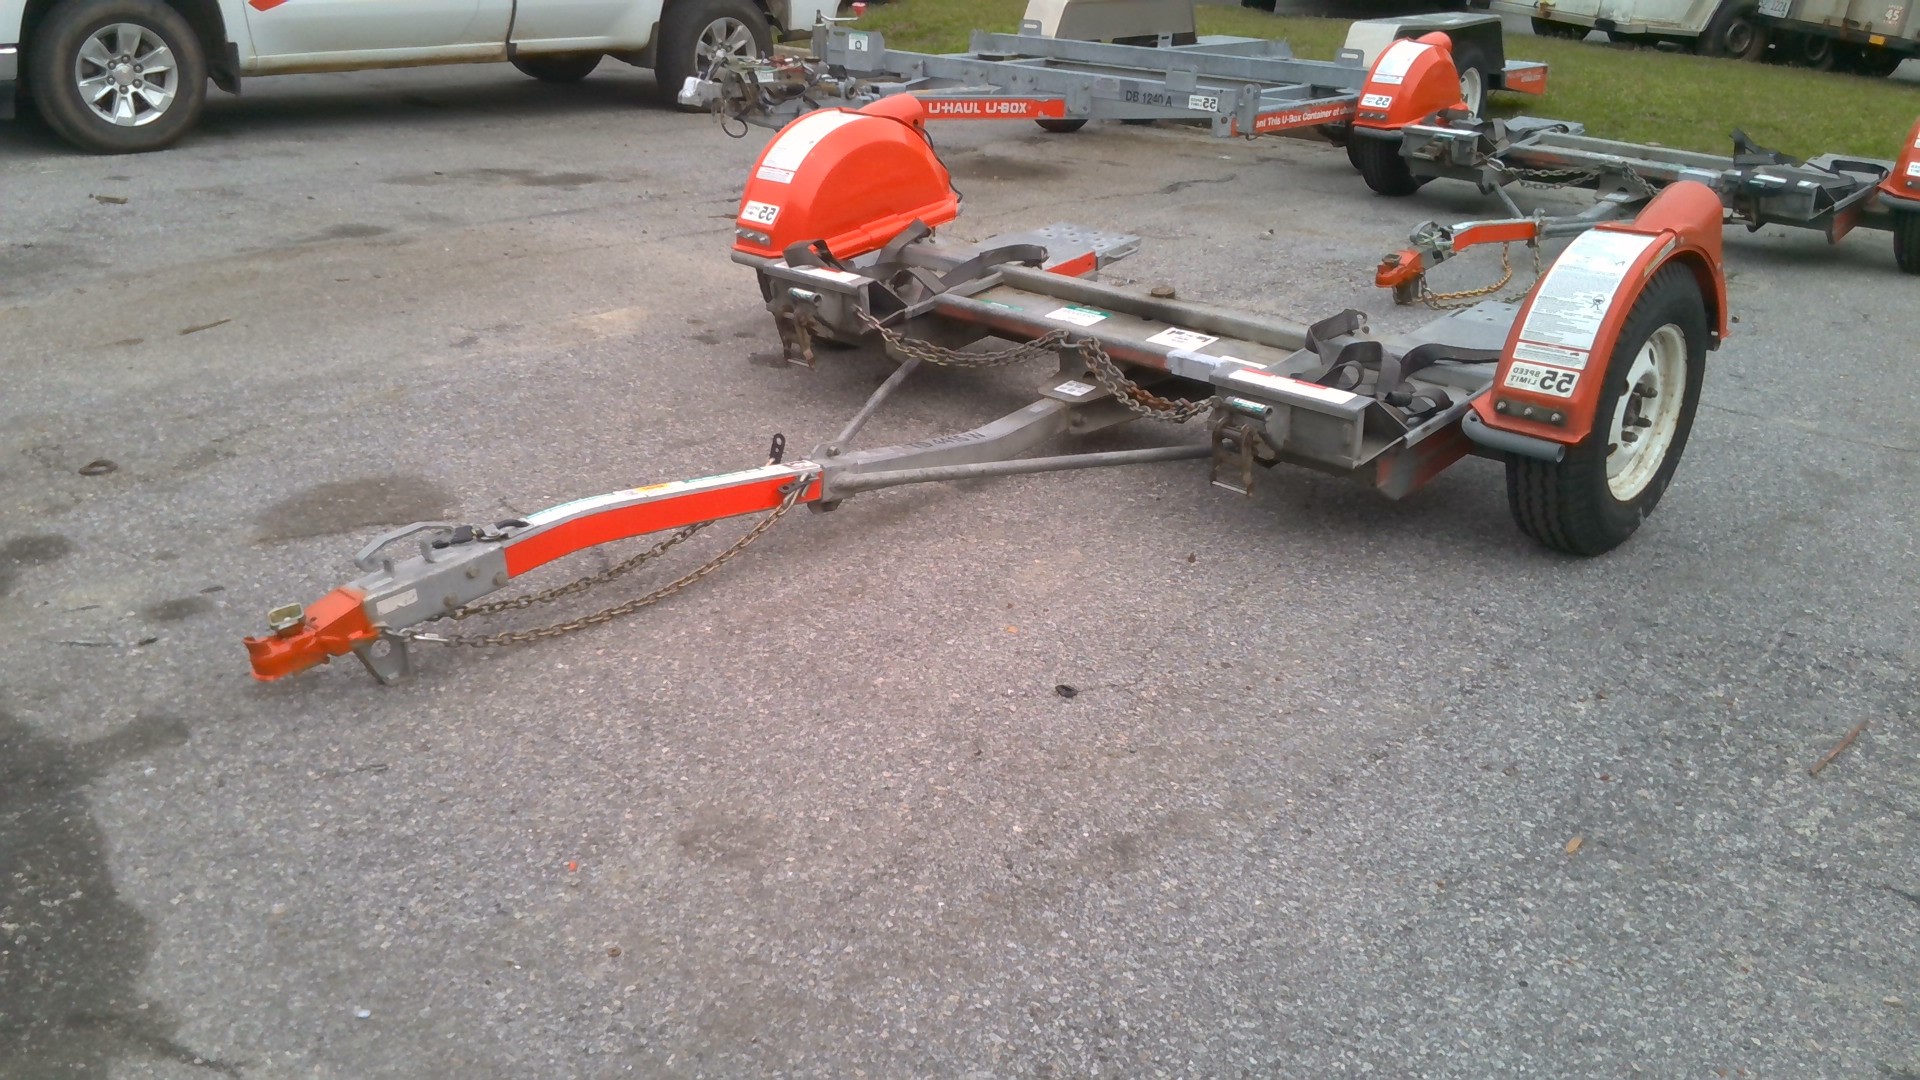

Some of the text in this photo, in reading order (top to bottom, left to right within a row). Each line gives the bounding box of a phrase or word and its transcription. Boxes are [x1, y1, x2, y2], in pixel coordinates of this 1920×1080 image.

[1885, 9, 1900, 20] 45
[1125, 90, 1139, 103] DB
[1165, 95, 1173, 107] A
[928, 102, 1028, 114] U-HAUL U-BOX
[1267, 116, 1281, 126] This
[1281, 113, 1301, 125] U-Box
[1302, 109, 1332, 122] Container
